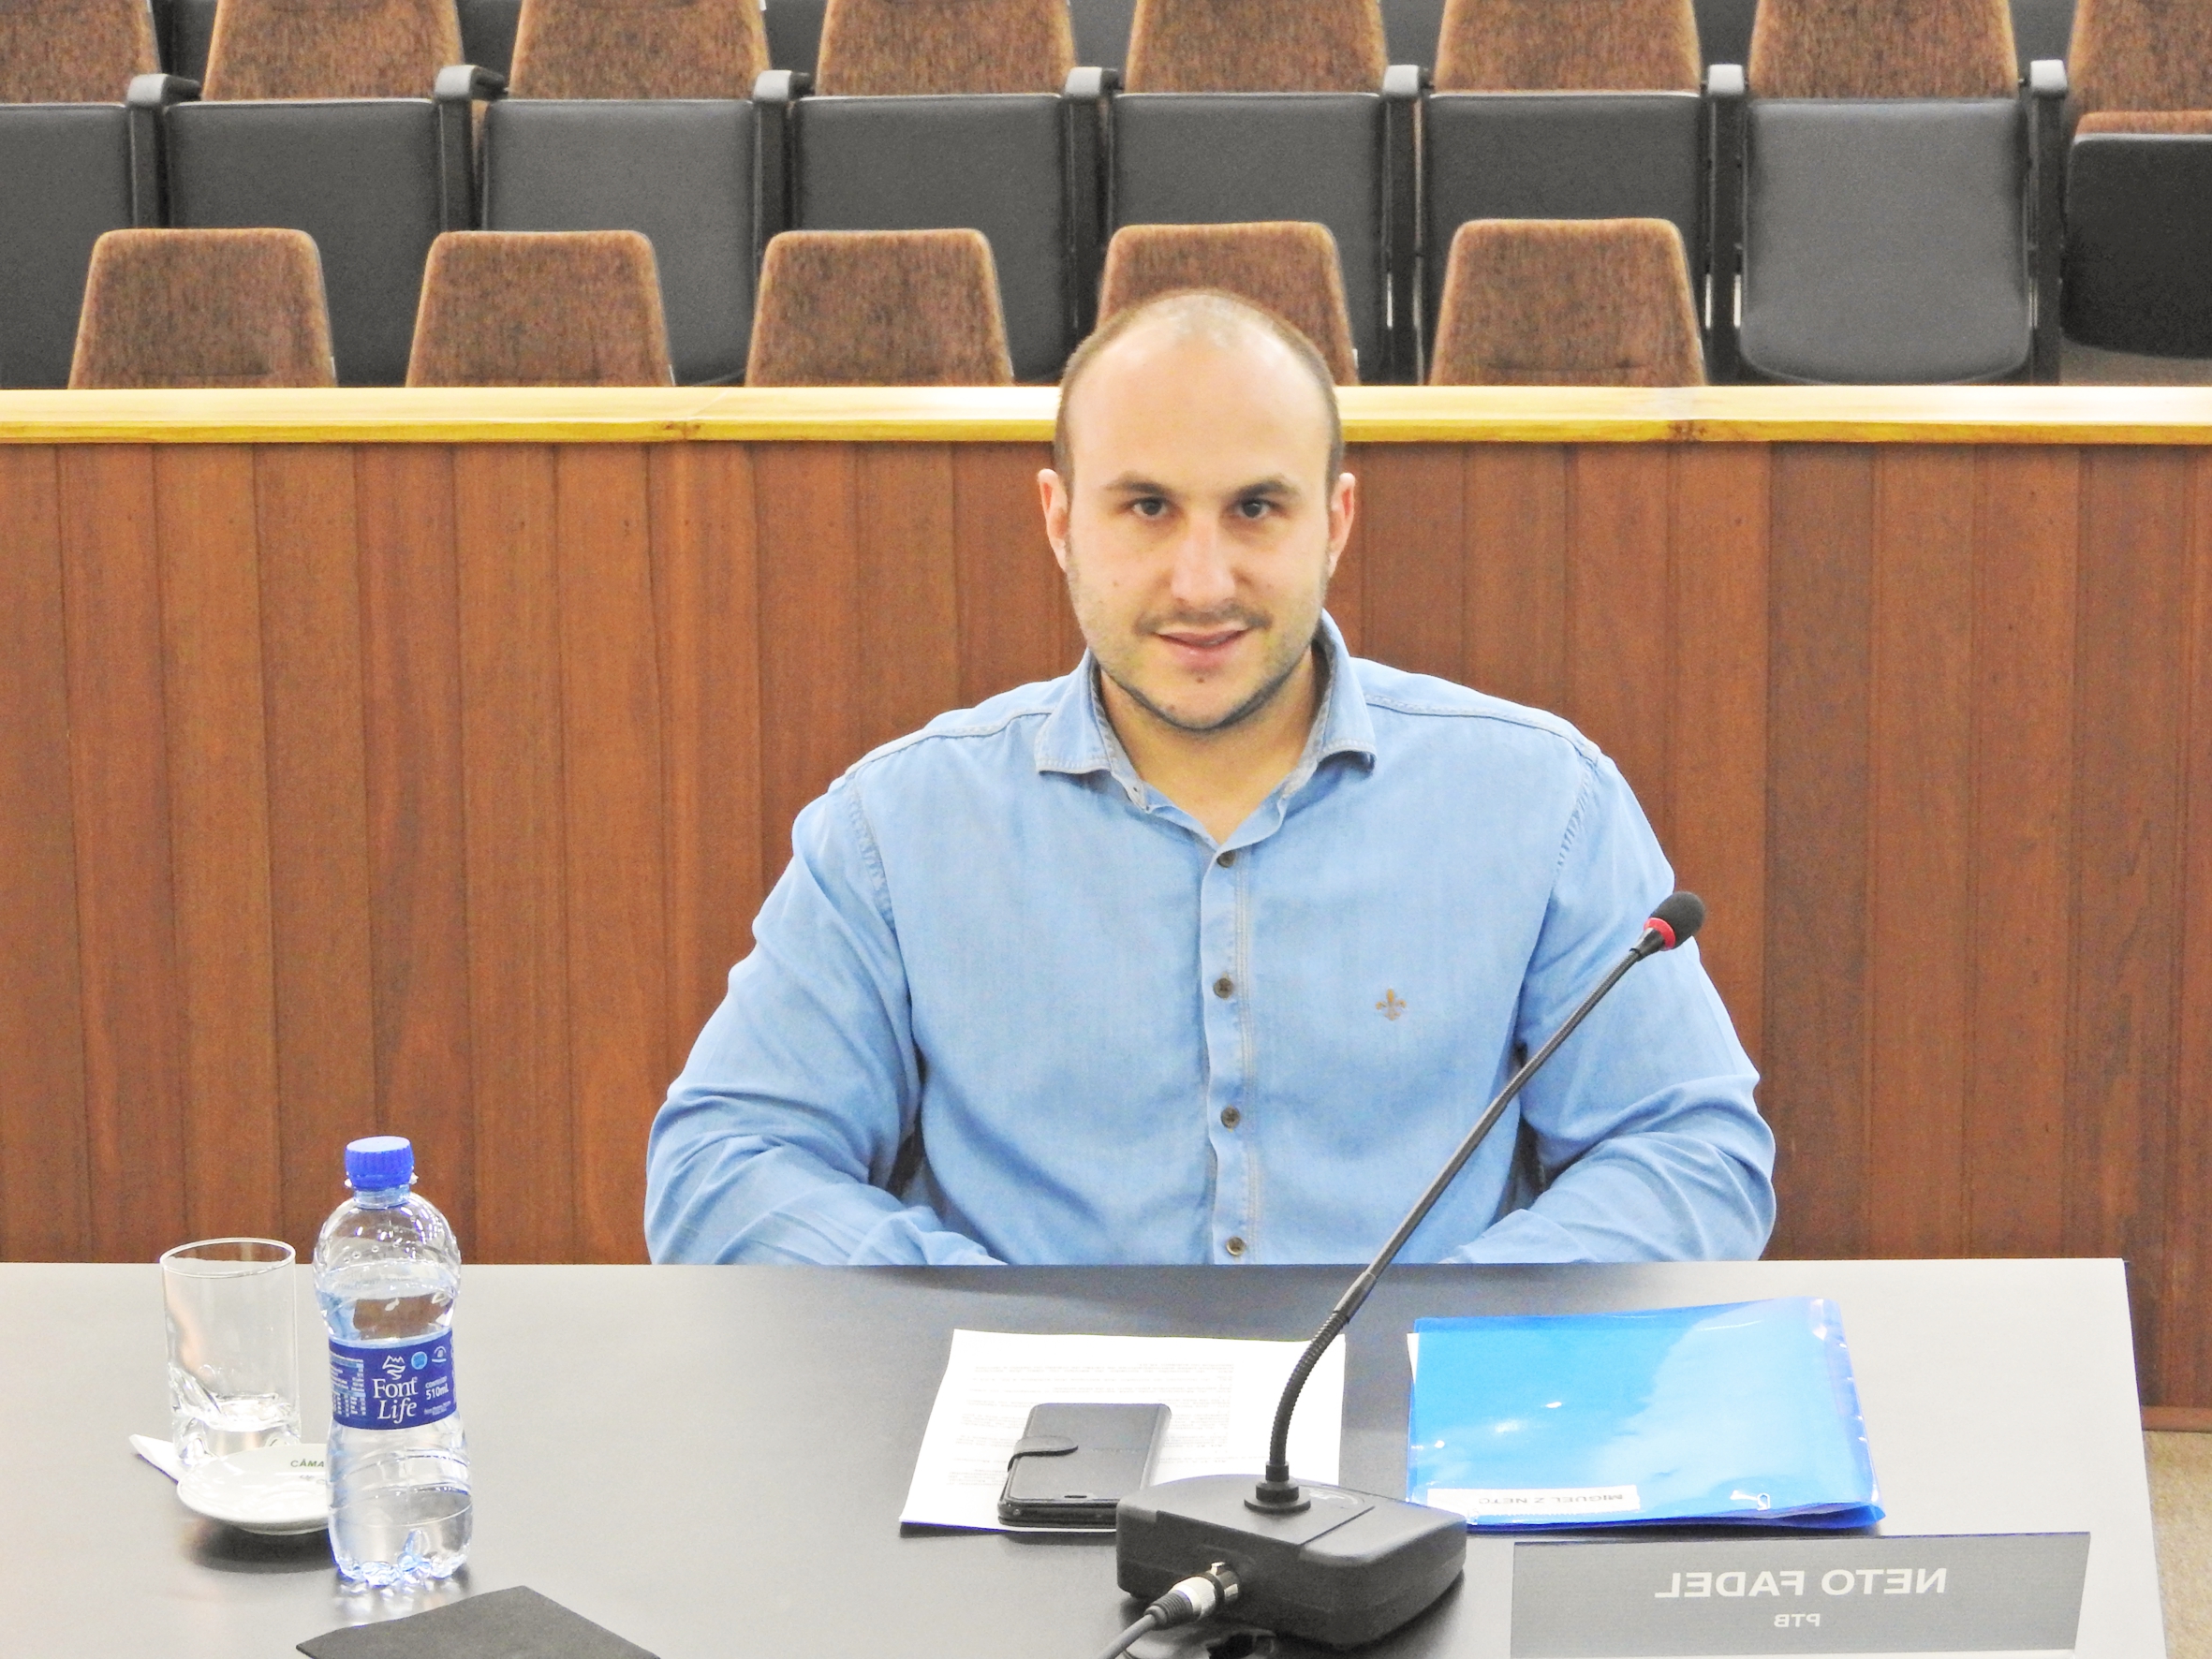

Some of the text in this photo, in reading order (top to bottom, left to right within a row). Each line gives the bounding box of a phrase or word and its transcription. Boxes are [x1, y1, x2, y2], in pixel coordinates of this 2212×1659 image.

[372, 1377, 419, 1399] Font
[376, 1397, 417, 1424] Life
[290, 1458, 325, 1468] CÂMA
[1551, 1493, 1624, 1504] MIGUEL
